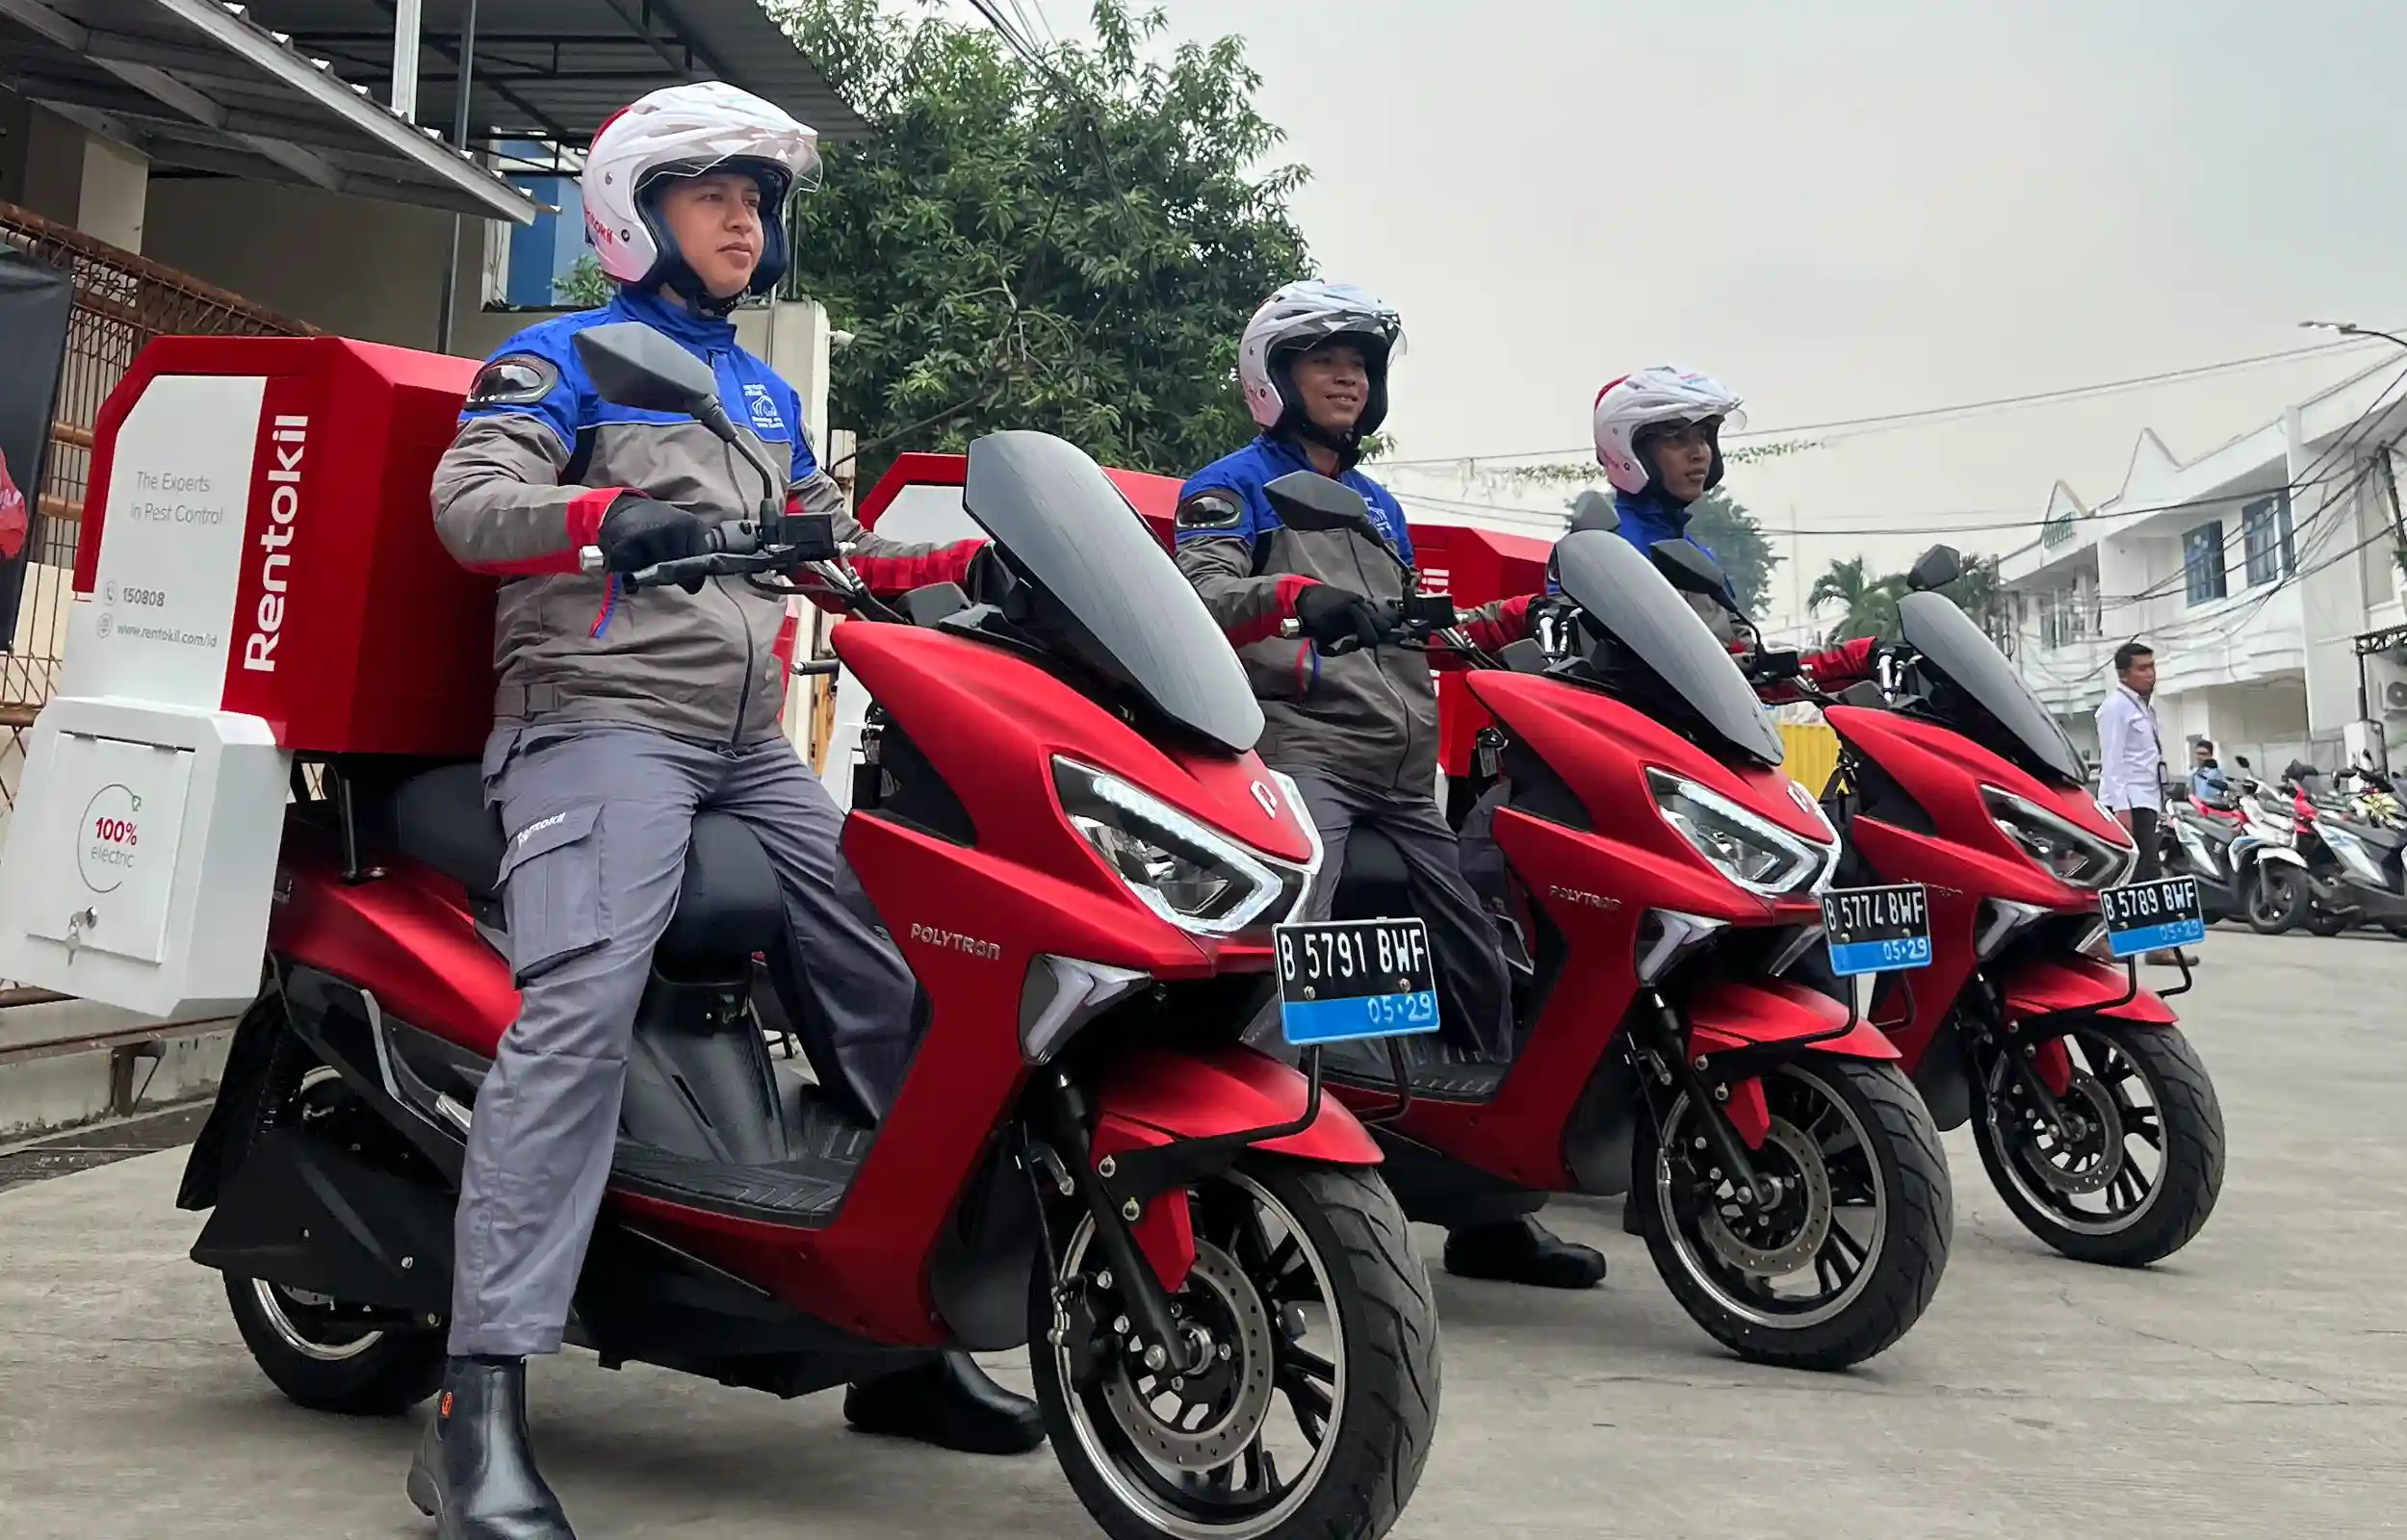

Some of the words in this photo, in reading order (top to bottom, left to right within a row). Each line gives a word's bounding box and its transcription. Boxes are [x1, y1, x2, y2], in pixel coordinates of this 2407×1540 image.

[137, 471, 158, 490] The
[162, 473, 211, 493] Experts
[144, 502, 172, 521] Pest
[174, 504, 223, 525] Control
[244, 415, 309, 672] Rentokil
[122, 587, 166, 607] 150808
[116, 624, 218, 648] www.rentokil.com/id
[95, 816, 138, 846] 100%
[91, 843, 137, 868] electric
[1825, 897, 1837, 932] B
[1887, 890, 1924, 926] BWF
[2102, 893, 2115, 921] B
[2117, 886, 2160, 917] 5789
[2161, 881, 2196, 911] BWF
[1280, 933, 1296, 982] B
[1304, 931, 1367, 979] 5791
[1376, 928, 1425, 974] BWF
